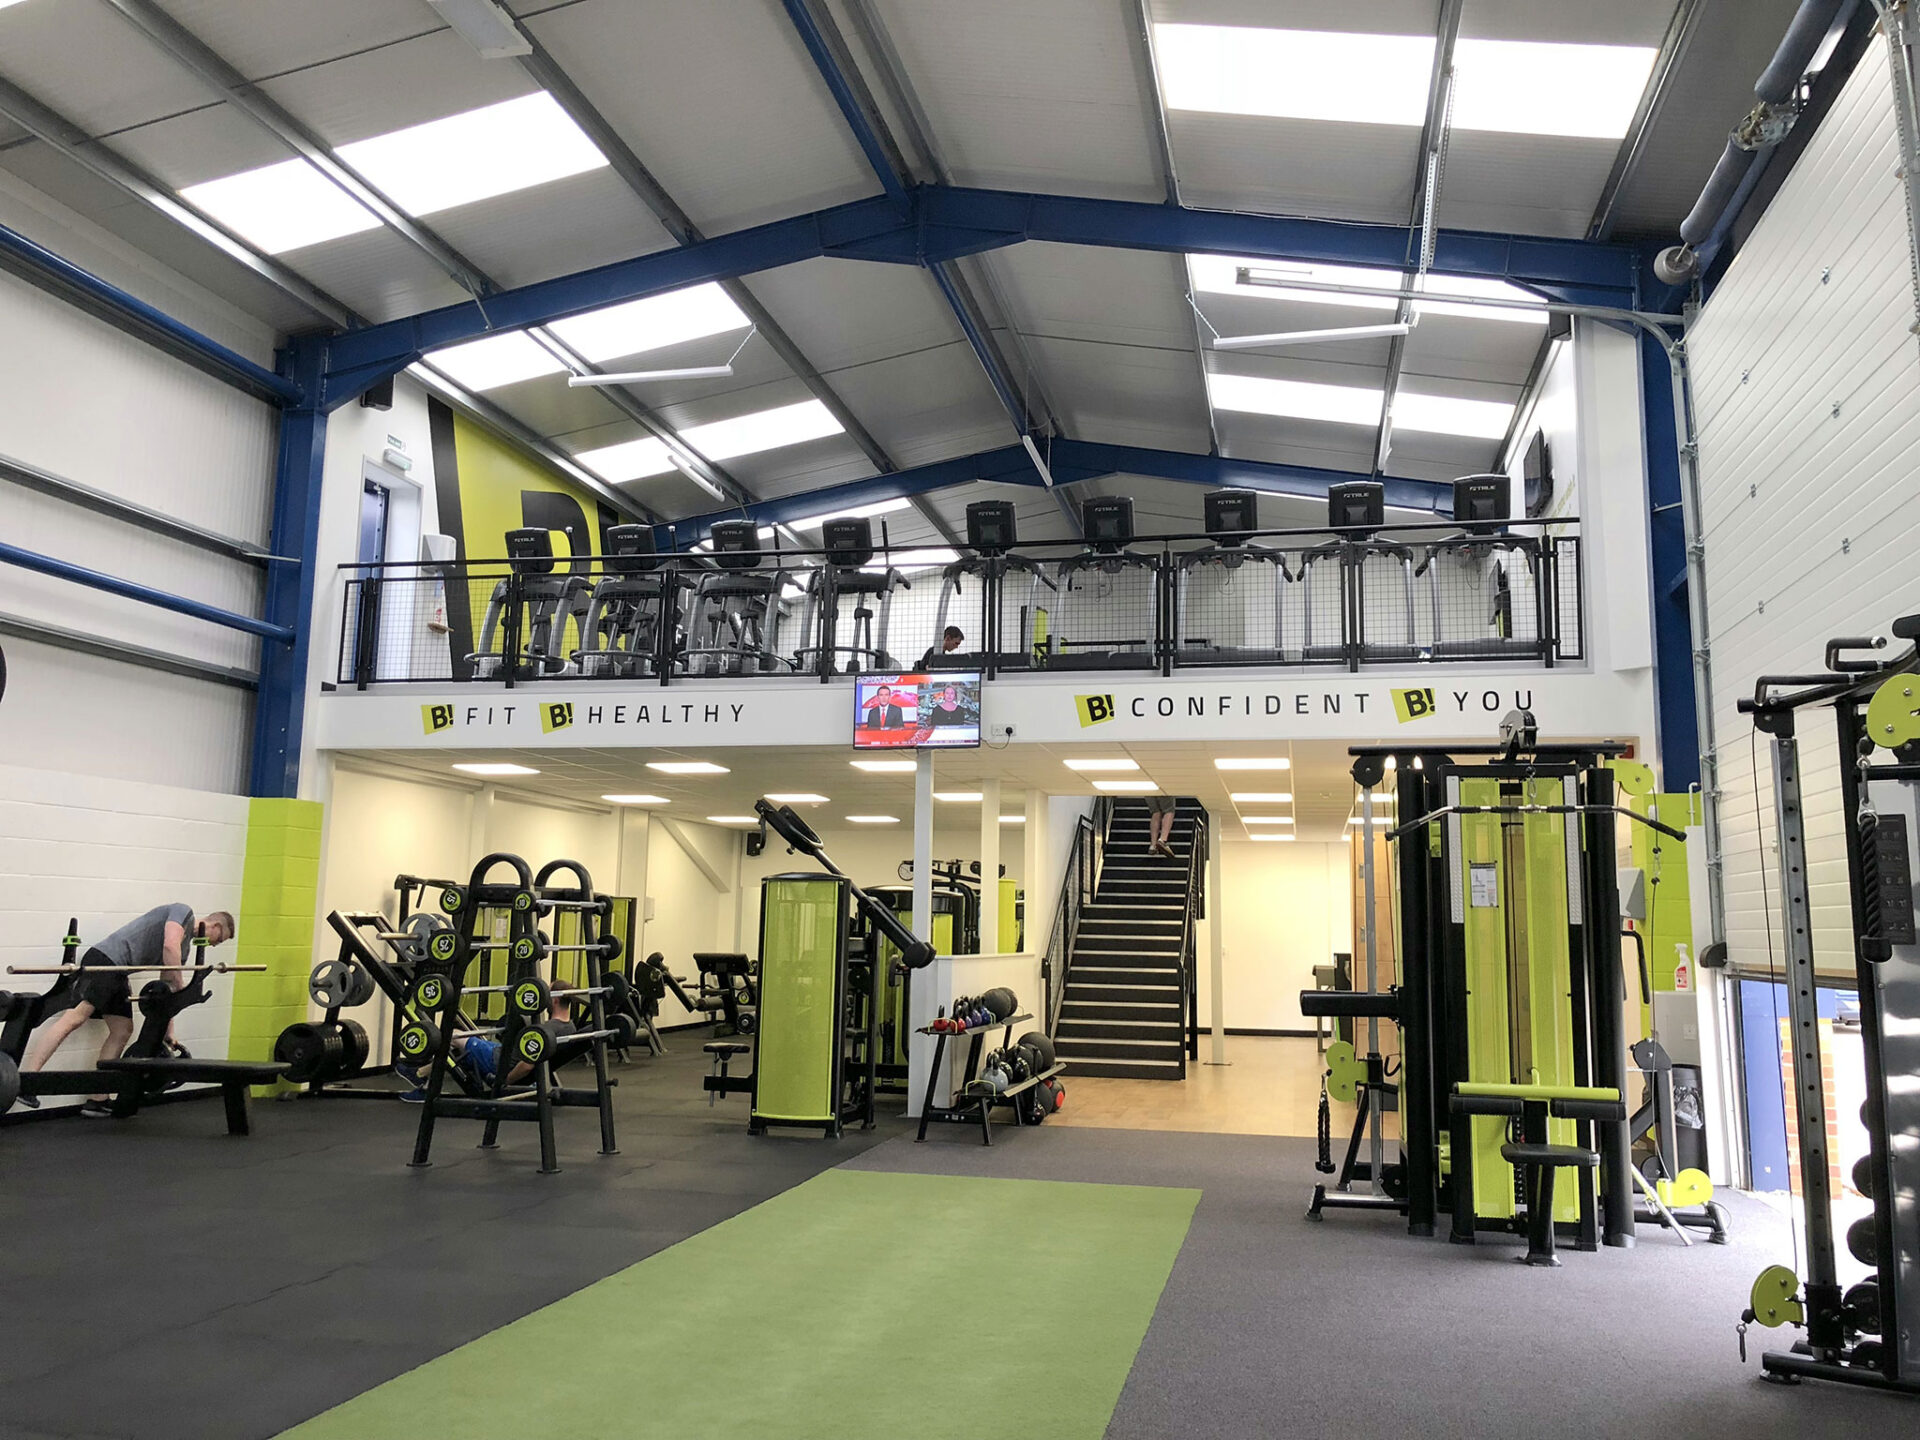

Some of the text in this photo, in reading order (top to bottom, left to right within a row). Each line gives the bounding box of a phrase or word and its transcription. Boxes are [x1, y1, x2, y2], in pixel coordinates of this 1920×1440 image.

[1086, 687, 1533, 722] B! CONFIDENT B! YOU
[431, 702, 744, 730] B! FIT B! HEALTHY
[440, 940, 450, 951] 25
[520, 945, 528, 954] 20
[524, 992, 534, 1003] 30
[407, 1035, 418, 1047] 45
[527, 1040, 539, 1052] 40
